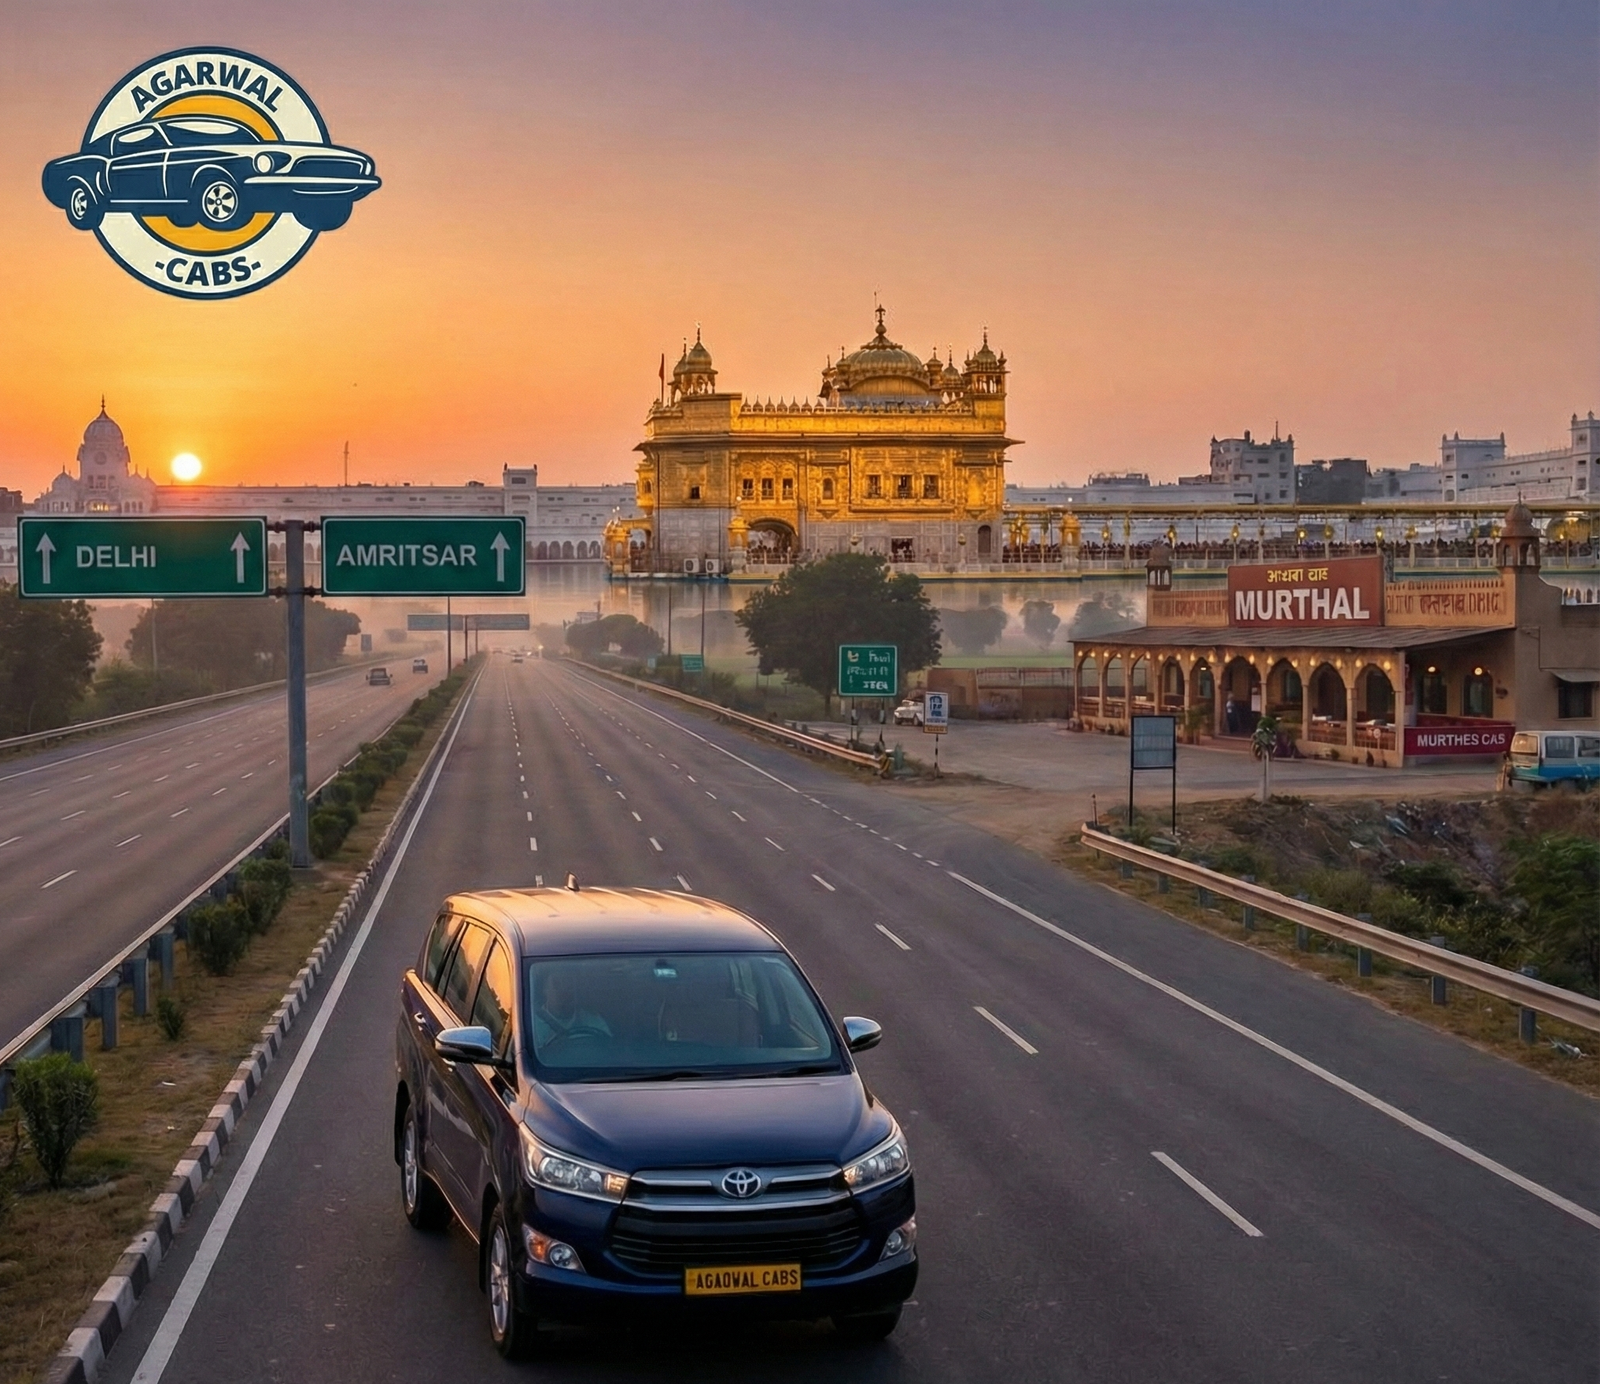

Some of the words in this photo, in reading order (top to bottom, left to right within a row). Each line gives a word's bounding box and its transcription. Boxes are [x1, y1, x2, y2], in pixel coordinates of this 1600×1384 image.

[76, 545, 156, 568] DELHI
[336, 544, 478, 567] AMRITSAR
[1235, 587, 1370, 620] MURTHAL
[1417, 734, 1480, 747] MURTHES
[762, 1269, 798, 1286] CABS
